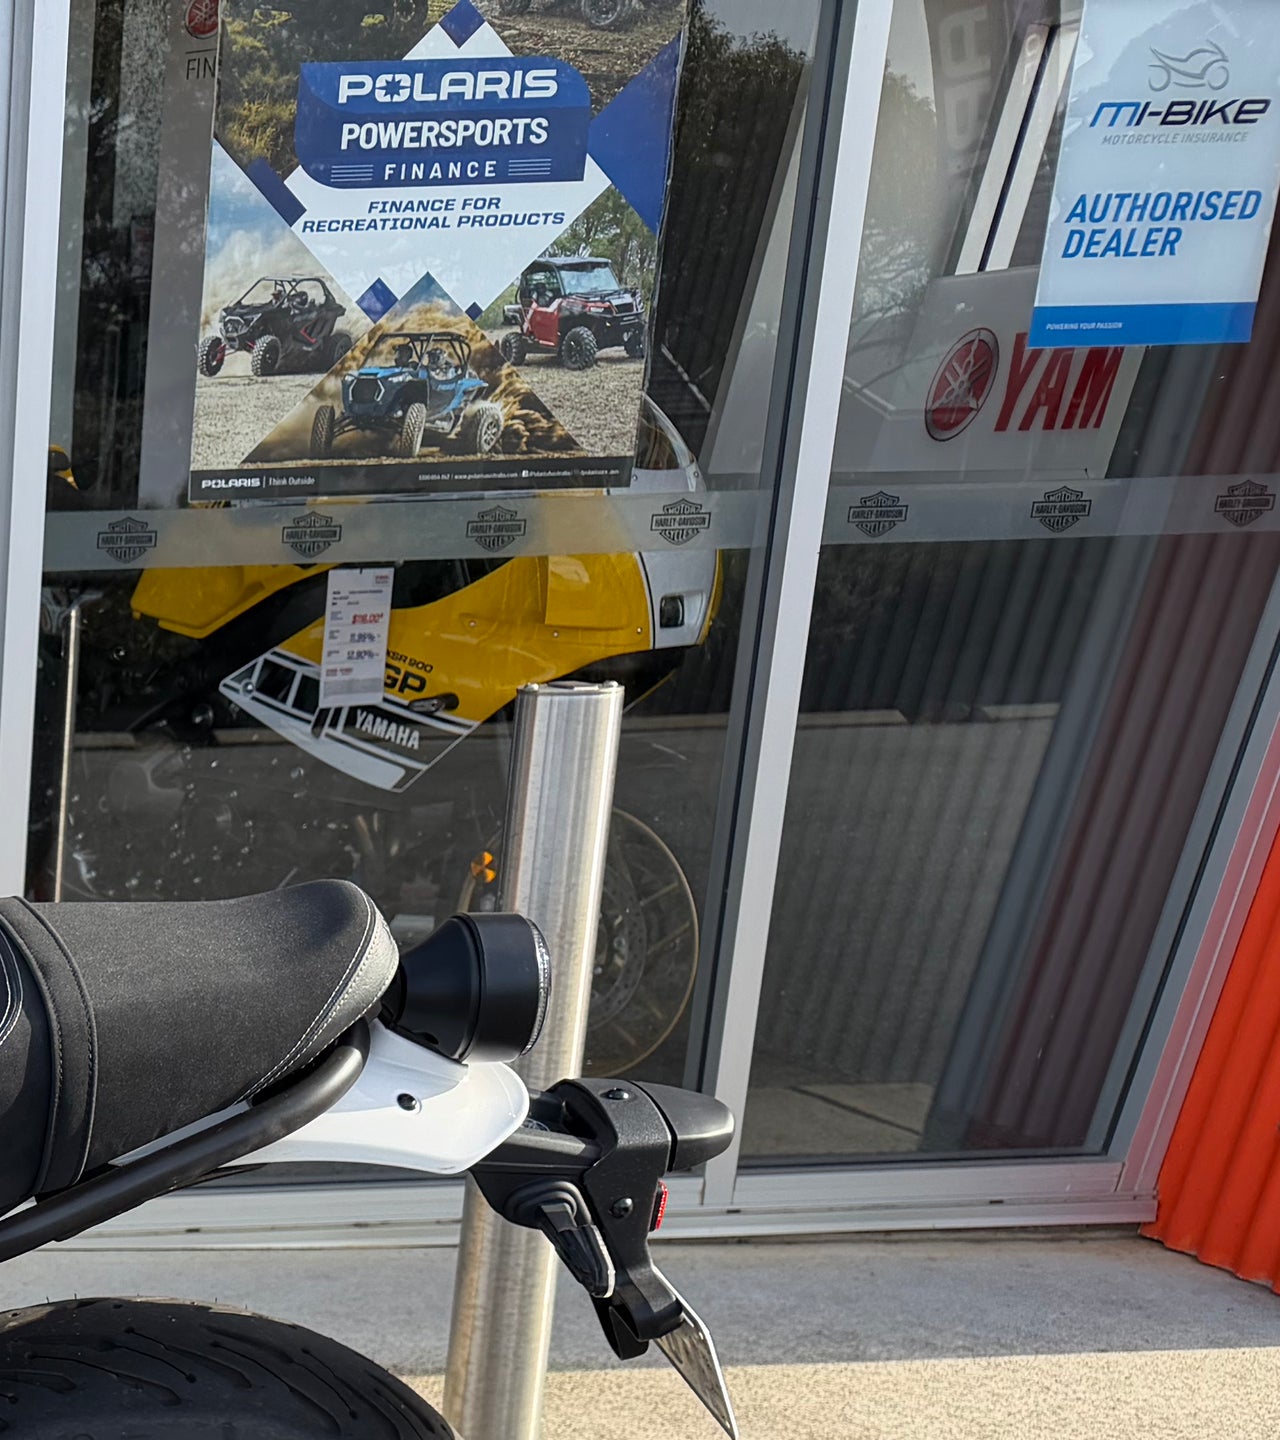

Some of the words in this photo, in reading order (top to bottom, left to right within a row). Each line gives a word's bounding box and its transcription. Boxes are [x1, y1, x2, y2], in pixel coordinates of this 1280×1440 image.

[338, 69, 558, 104] POLARIS
[341, 118, 549, 150] POWERSPORTS
[1102, 133, 1179, 145] MOTORCYCLE
[1181, 131, 1248, 143] INSURANCE
[384, 161, 497, 181] FINANCE
[368, 199, 456, 214] FINANCE
[462, 197, 501, 210] FOR
[1065, 190, 1262, 223] AUTHORISED
[302, 216, 451, 233] RECREATIONAL
[457, 212, 565, 228] PRODUCTS
[1062, 227, 1182, 258] DEALER
[201, 477, 261, 489] POLARIS
[1034, 503, 1088, 514] HARLEY-DAVIDSON
[470, 523, 522, 534] HARLEY-DAVIDSON
[654, 516, 707, 527] HARLEY-DAVIDSON
[285, 528, 338, 540] HARLEY-DAVIDSON
[408, 657, 434, 673] 900
[355, 709, 420, 750] YAMAHA
